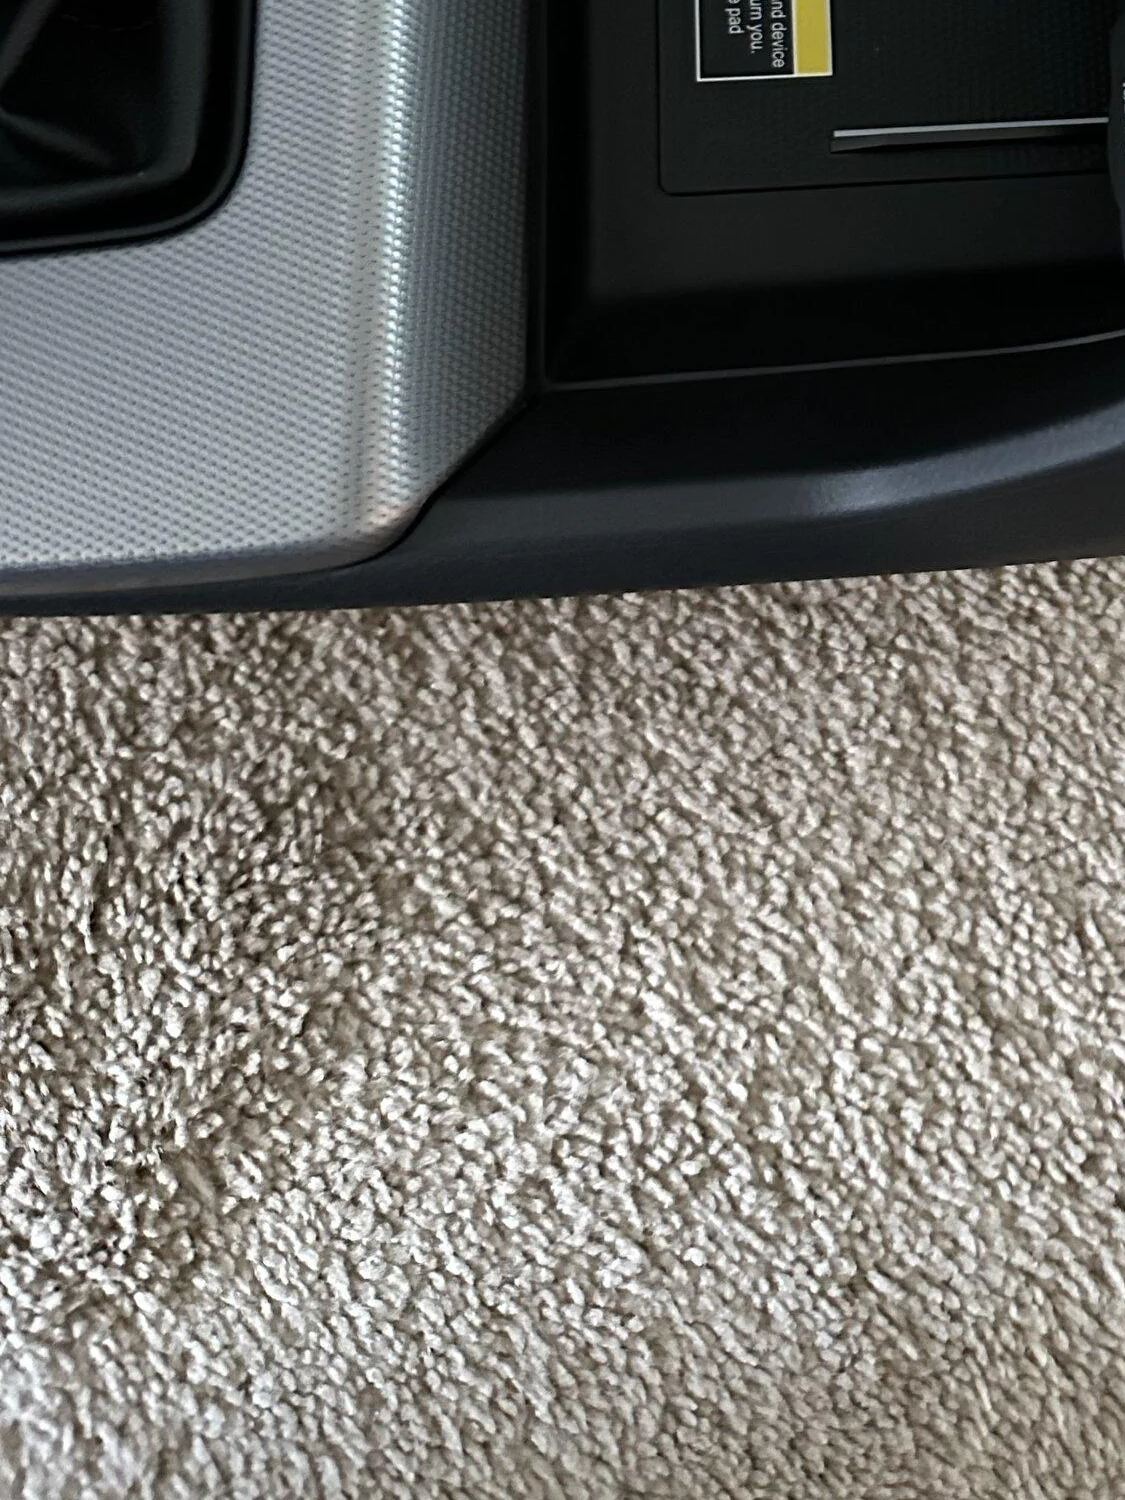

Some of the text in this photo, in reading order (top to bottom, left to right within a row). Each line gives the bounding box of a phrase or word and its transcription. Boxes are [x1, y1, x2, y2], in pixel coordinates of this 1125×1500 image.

[724, 8, 744, 34] pad
[746, 24, 764, 54] you.
[771, 23, 788, 68] device
